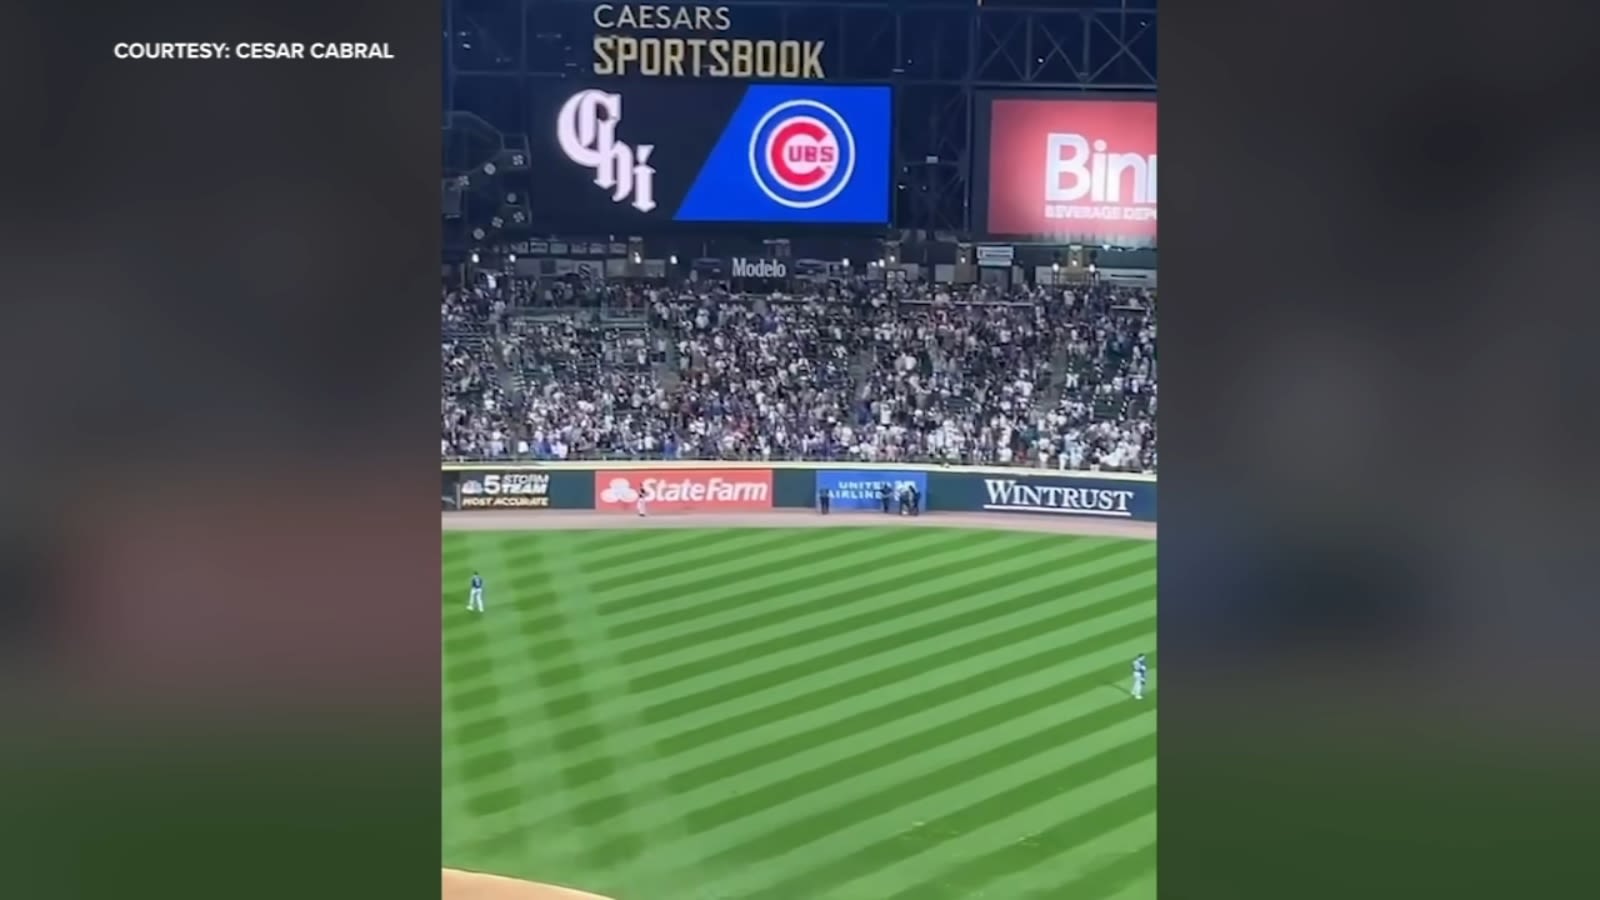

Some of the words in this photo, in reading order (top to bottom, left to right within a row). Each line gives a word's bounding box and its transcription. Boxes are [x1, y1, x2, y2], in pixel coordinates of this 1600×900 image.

[593, 3, 731, 30] CAESARS
[593, 36, 825, 79] SPORTSBOOK
[557, 88, 657, 213] Chi
[1045, 132, 1157, 204] Bin
[1045, 204, 1120, 220] BEVERAGE
[732, 256, 787, 278] Modelo
[484, 474, 501, 495] 5
[502, 474, 550, 485] STORM
[502, 484, 547, 495] TEAM
[838, 480, 891, 490] UNITE
[463, 496, 493, 506] MOST
[494, 497, 549, 507] ACCURATE
[984, 478, 1134, 511] WINTRUST
